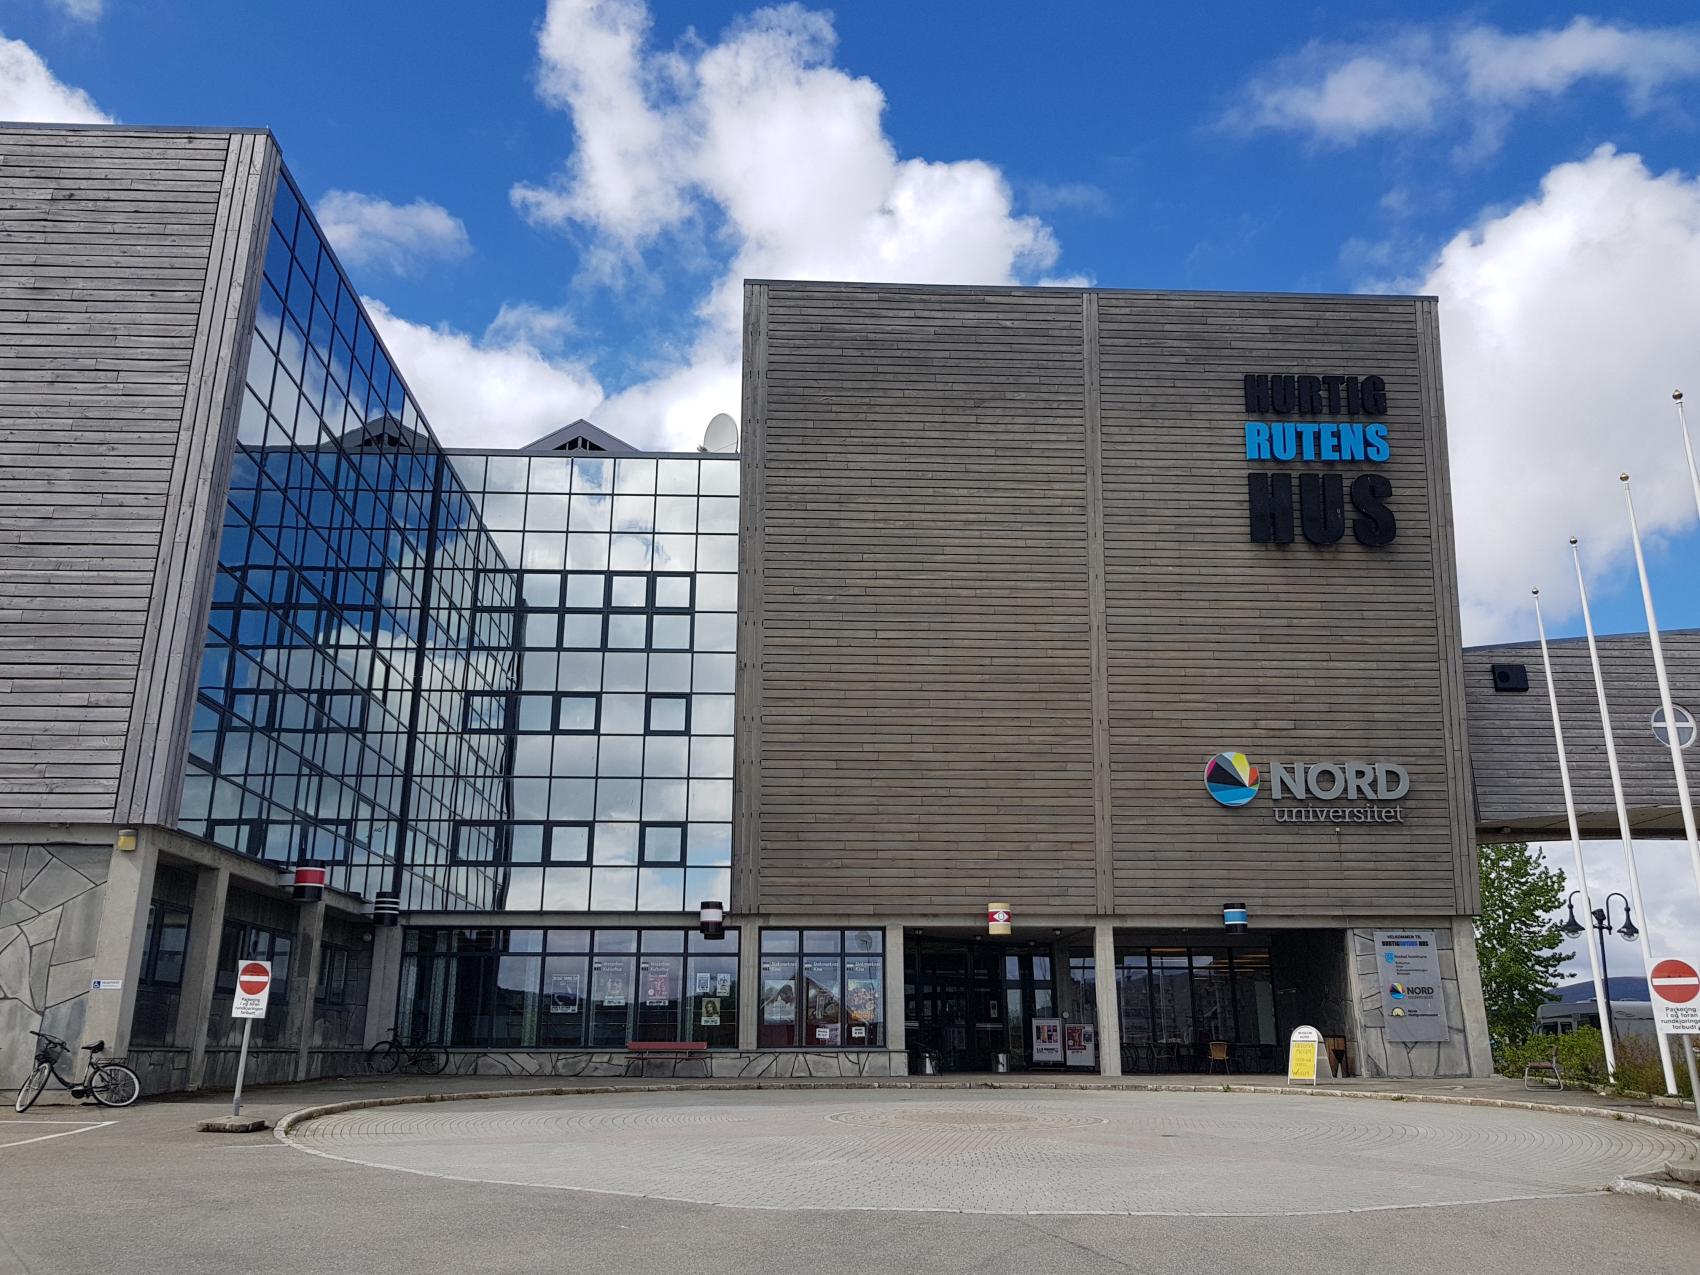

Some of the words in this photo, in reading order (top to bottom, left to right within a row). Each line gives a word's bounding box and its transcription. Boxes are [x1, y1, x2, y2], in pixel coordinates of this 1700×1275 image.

[1244, 375, 1387, 415] HURTIG
[1245, 422, 1390, 462] RUTENS
[1248, 473, 1396, 546] HUS
[1270, 762, 1410, 799] NORD
[1273, 804, 1404, 823] universitet
[1407, 987, 1434, 995] NORD
